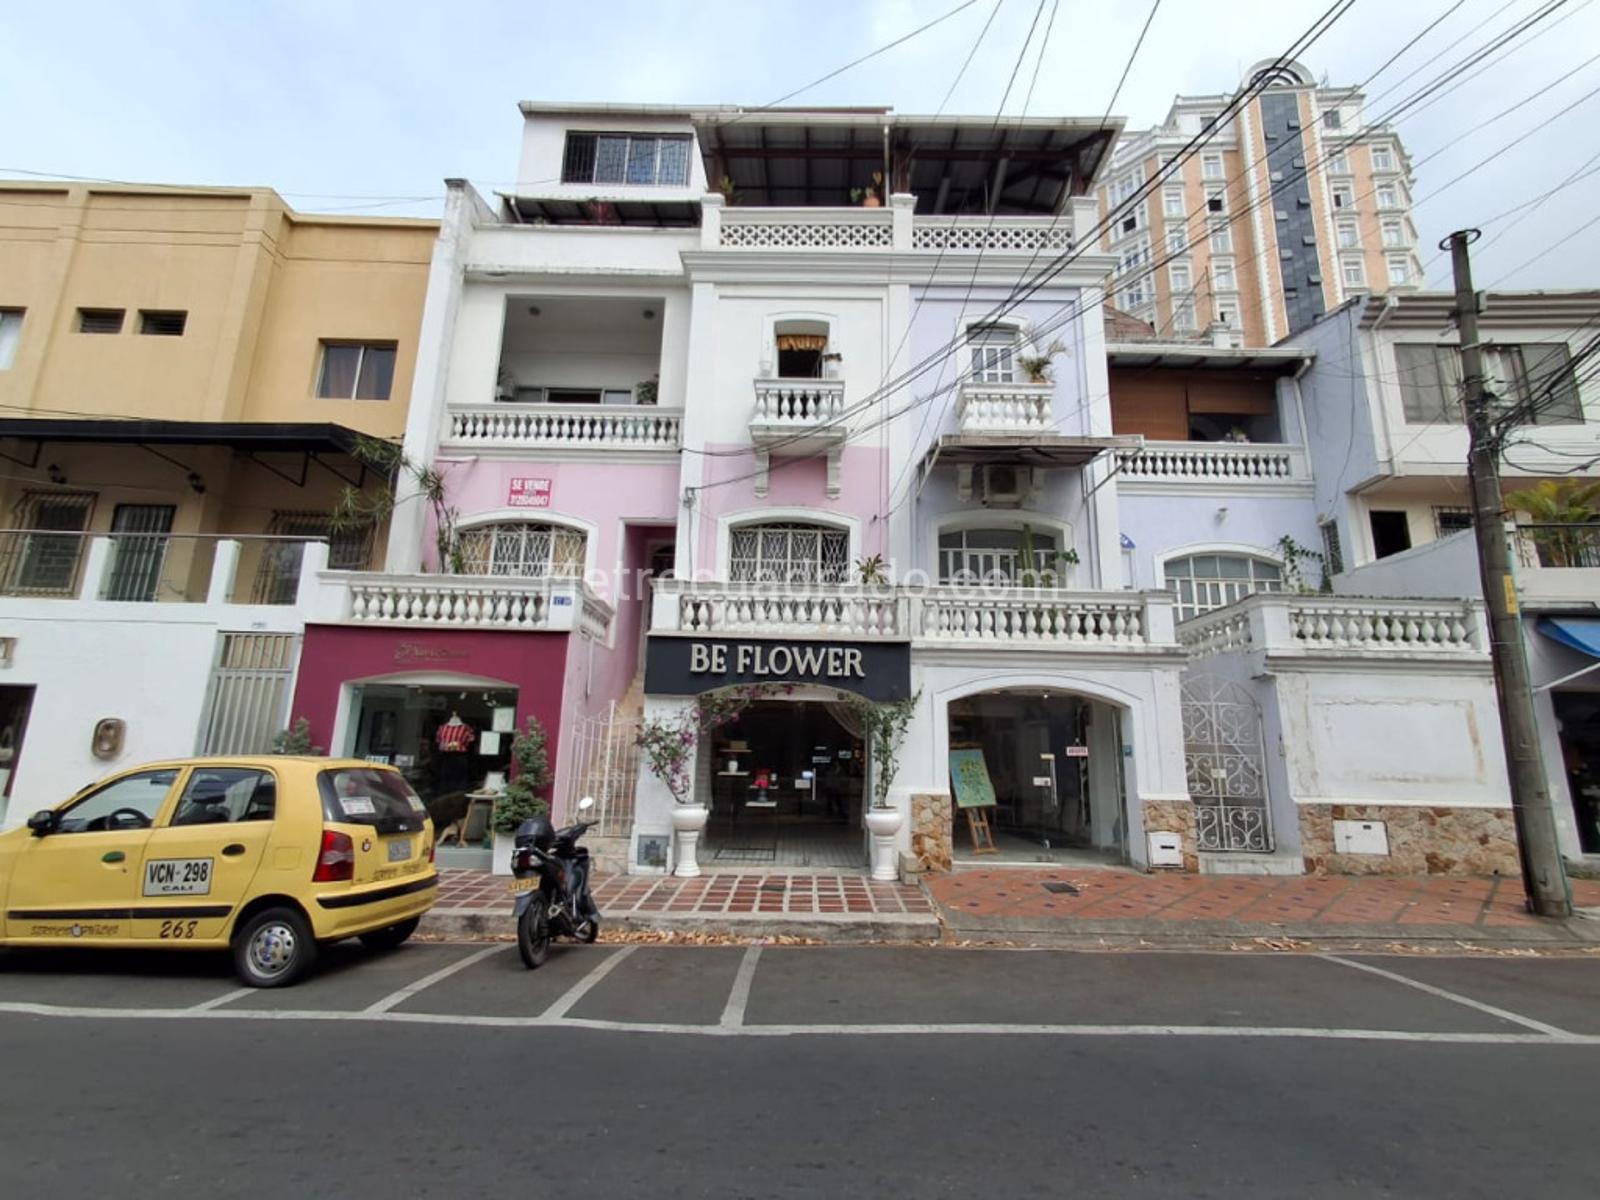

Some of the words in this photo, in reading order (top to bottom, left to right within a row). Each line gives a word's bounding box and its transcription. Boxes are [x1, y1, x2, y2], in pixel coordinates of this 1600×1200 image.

[690, 643, 727, 673] BE
[737, 645, 865, 677] FLOWER
[159, 920, 198, 938] 268
